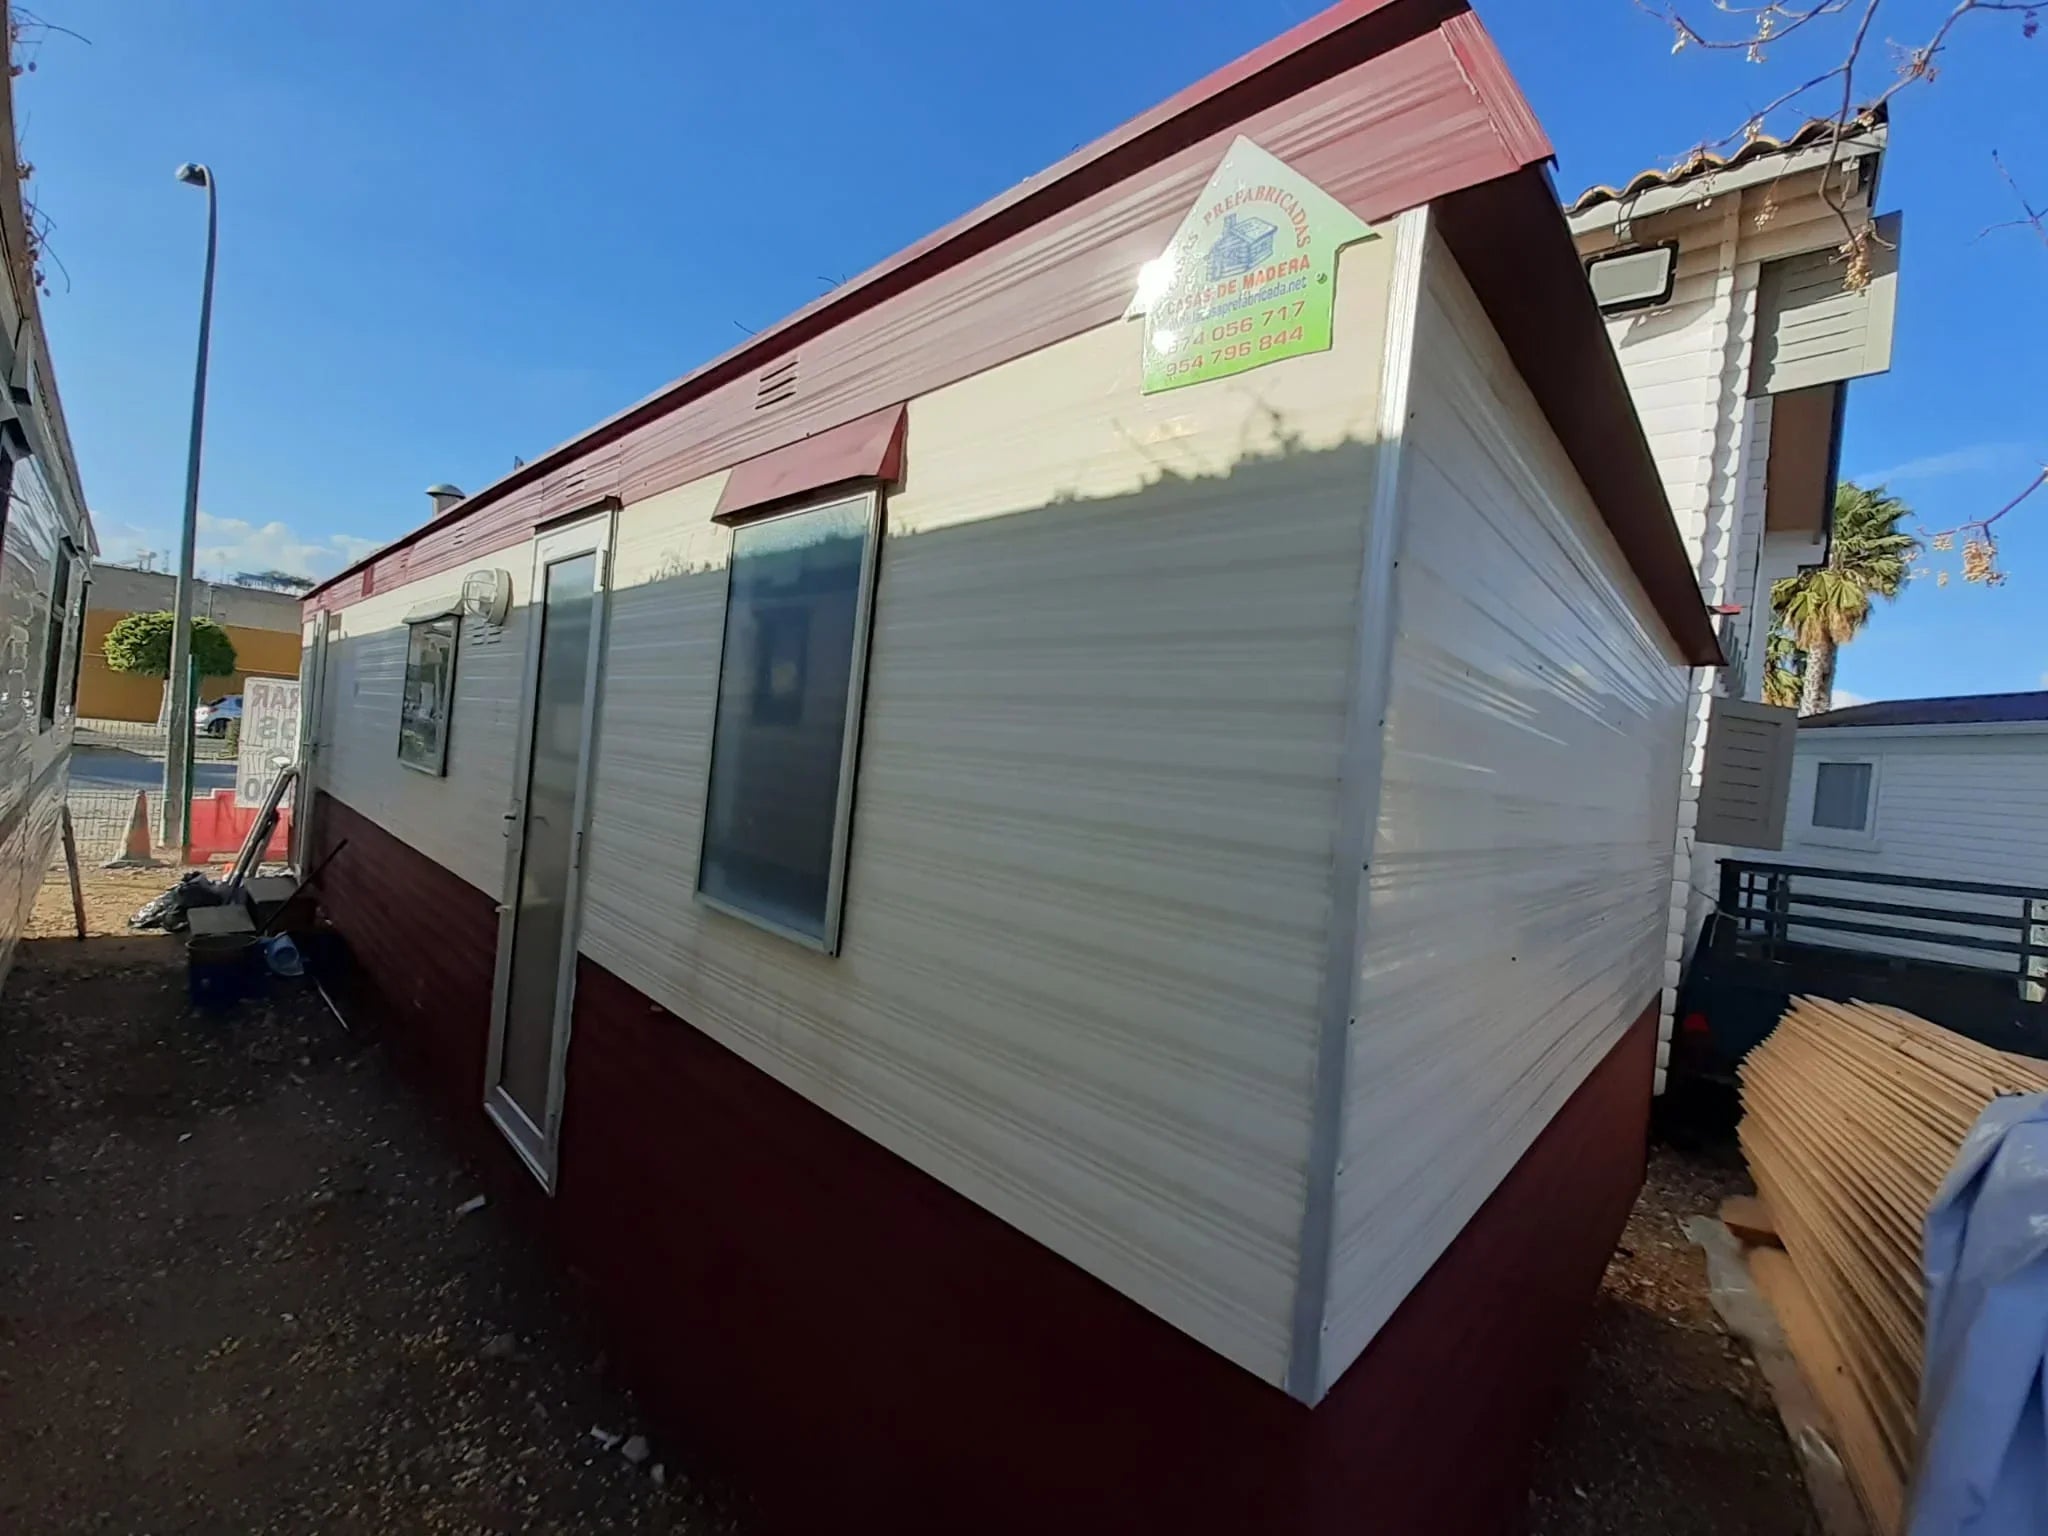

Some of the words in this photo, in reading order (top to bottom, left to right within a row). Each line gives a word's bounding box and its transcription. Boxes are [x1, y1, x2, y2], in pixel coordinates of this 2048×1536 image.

[1203, 185, 1311, 249] PREFABRICADAS
[1167, 287, 1215, 315] CASAS
[1217, 279, 1237, 299] DE
[1242, 254, 1310, 290] MADERA
[1212, 317, 1253, 342] 056
[1261, 301, 1305, 326] 717
[1166, 355, 1204, 377] 954
[1210, 341, 1251, 365] 796
[1259, 326, 1304, 351] 844
